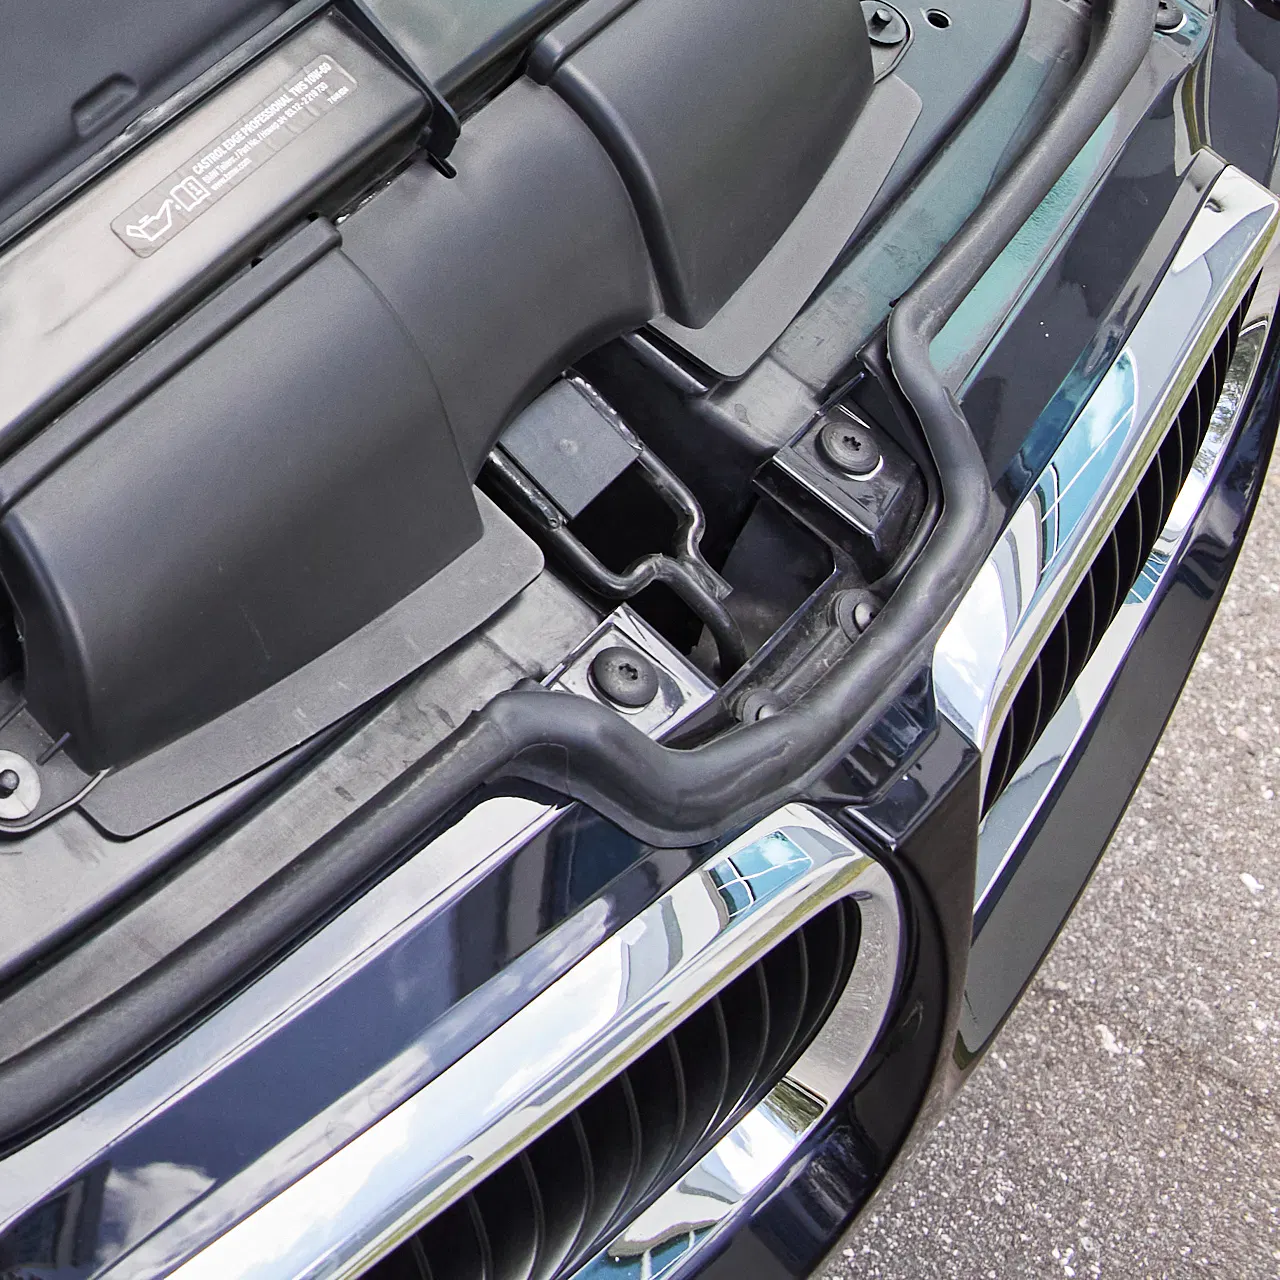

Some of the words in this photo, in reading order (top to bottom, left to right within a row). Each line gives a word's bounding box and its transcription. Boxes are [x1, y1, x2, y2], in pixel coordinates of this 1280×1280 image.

[192, 146, 227, 175] CASTROL
[221, 130, 246, 151] EDGE
[240, 94, 293, 136] PROFESSIONAL
[304, 62, 332, 85] 10W-60
